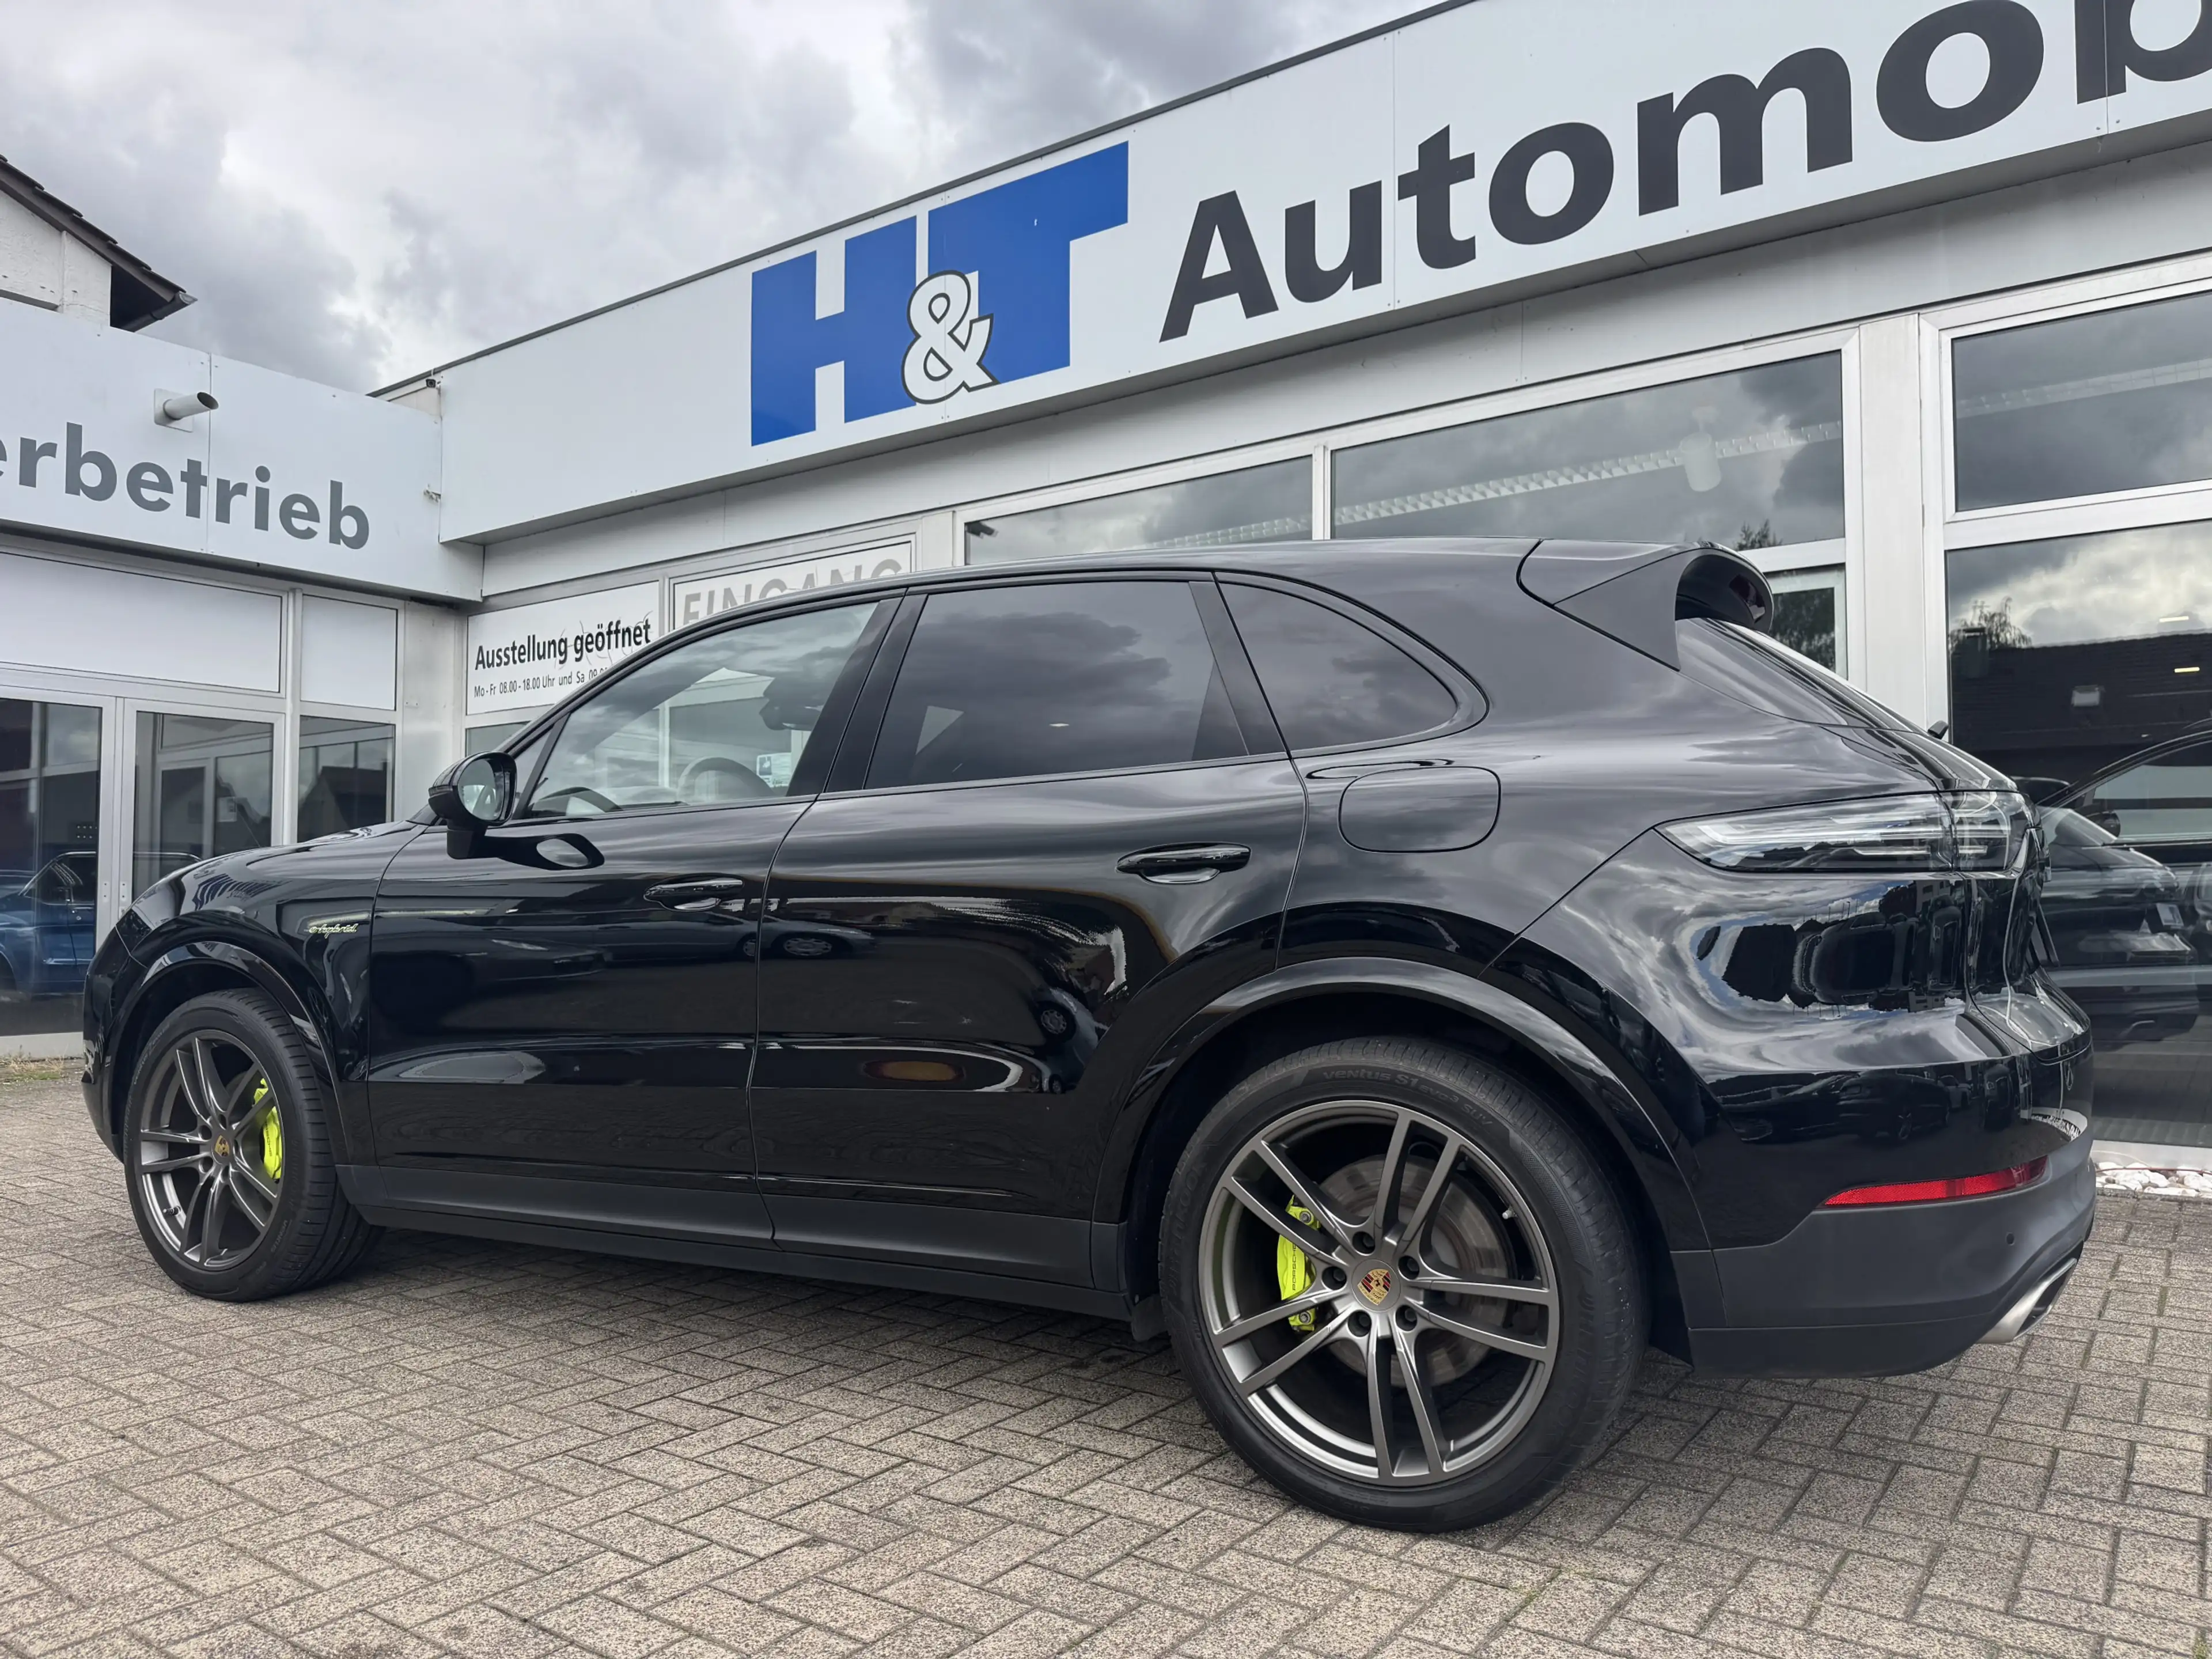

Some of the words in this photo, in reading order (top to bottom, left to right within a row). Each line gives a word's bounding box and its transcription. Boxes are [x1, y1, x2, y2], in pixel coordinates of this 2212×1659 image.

[751, 141, 1129, 446] H&T
[0, 422, 370, 550] rbetrieb
[474, 685, 484, 698] Mo
[490, 683, 496, 696] Fr
[499, 680, 517, 694] 08.00
[522, 677, 540, 691] 18.00
[542, 674, 555, 688] Uhr
[559, 671, 573, 685] und
[576, 671, 585, 684] Sa
[475, 634, 567, 670] Ausstellung
[574, 618, 651, 662] geöffnet
